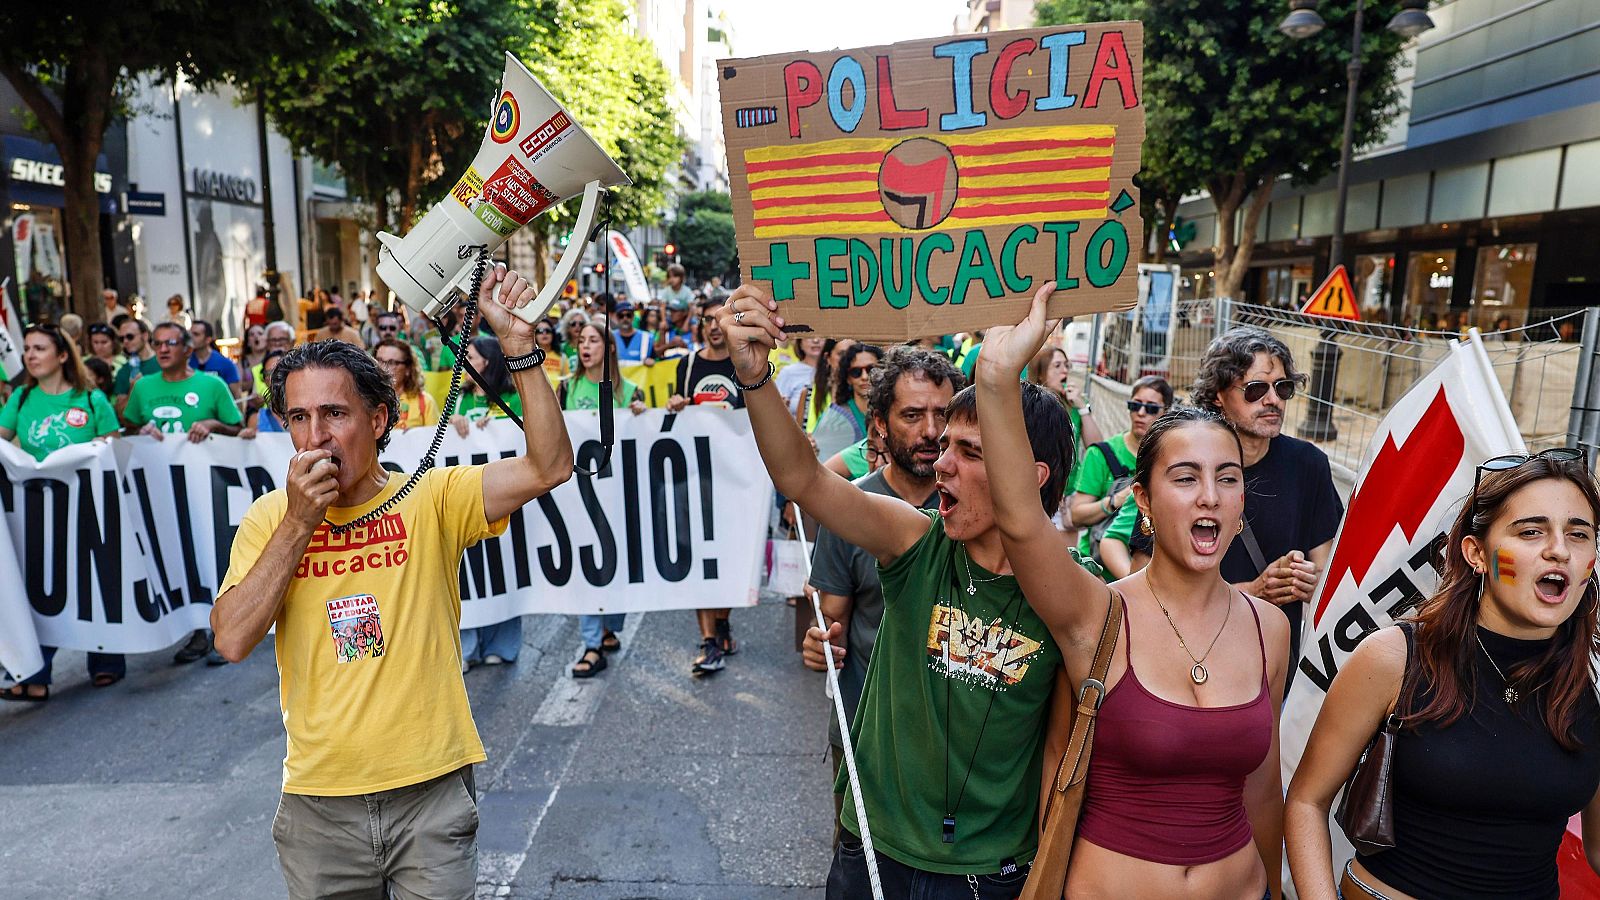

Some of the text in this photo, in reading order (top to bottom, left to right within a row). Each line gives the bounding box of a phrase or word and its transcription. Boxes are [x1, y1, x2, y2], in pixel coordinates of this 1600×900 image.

[11, 158, 113, 193] SKECS
[193, 168, 257, 202] MANGO
[480, 208, 504, 231] VAGA
[294, 542, 409, 578] ducació
[328, 597, 374, 611] LLUITAR
[344, 606, 377, 617] EDUCAR
